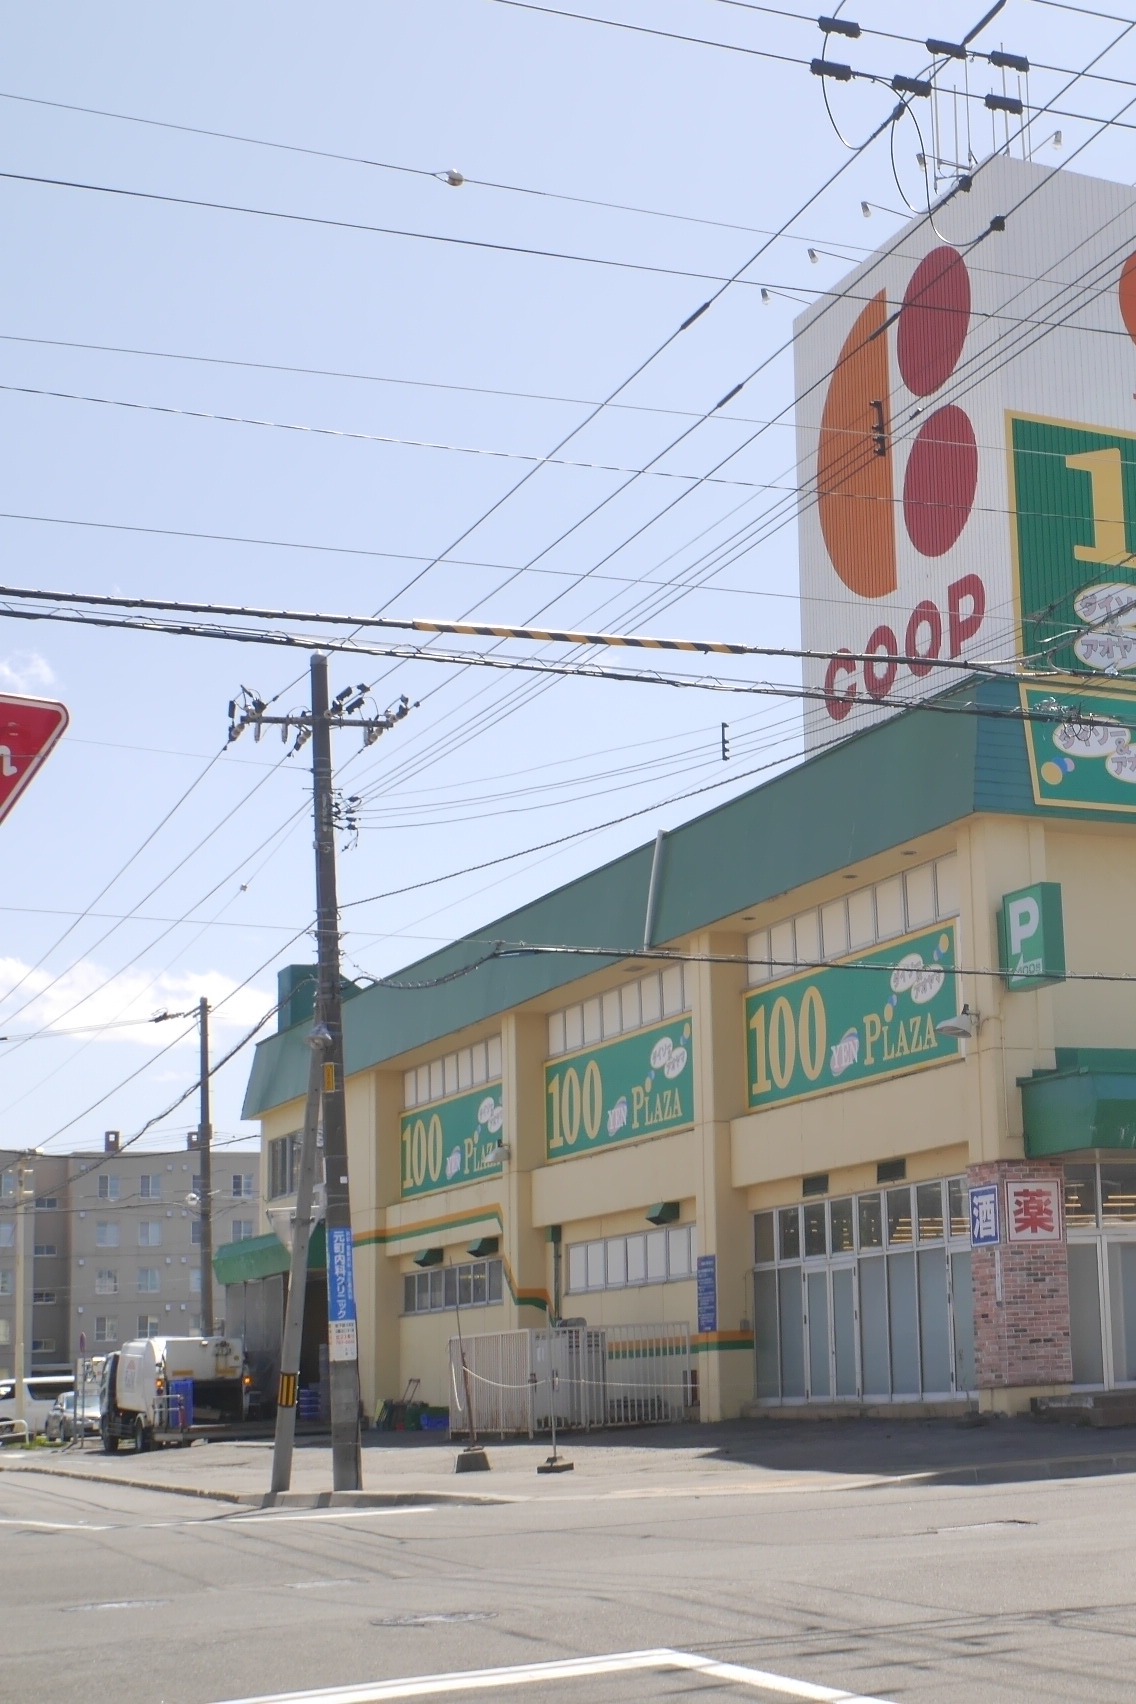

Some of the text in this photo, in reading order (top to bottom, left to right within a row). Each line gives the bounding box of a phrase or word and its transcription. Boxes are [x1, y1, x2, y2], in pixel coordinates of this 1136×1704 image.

[824, 574, 986, 720] COOP
[1114, 737, 1132, 755] &
[1008, 896, 1040, 955] P
[749, 986, 938, 1095] 100 YEN PLAZA
[548, 1060, 603, 1149] 100
[631, 1085, 683, 1130] PLAZA
[402, 1113, 443, 1189] 100
[972, 1193, 996, 1239] 酒
[1013, 1188, 1054, 1233] 薬
